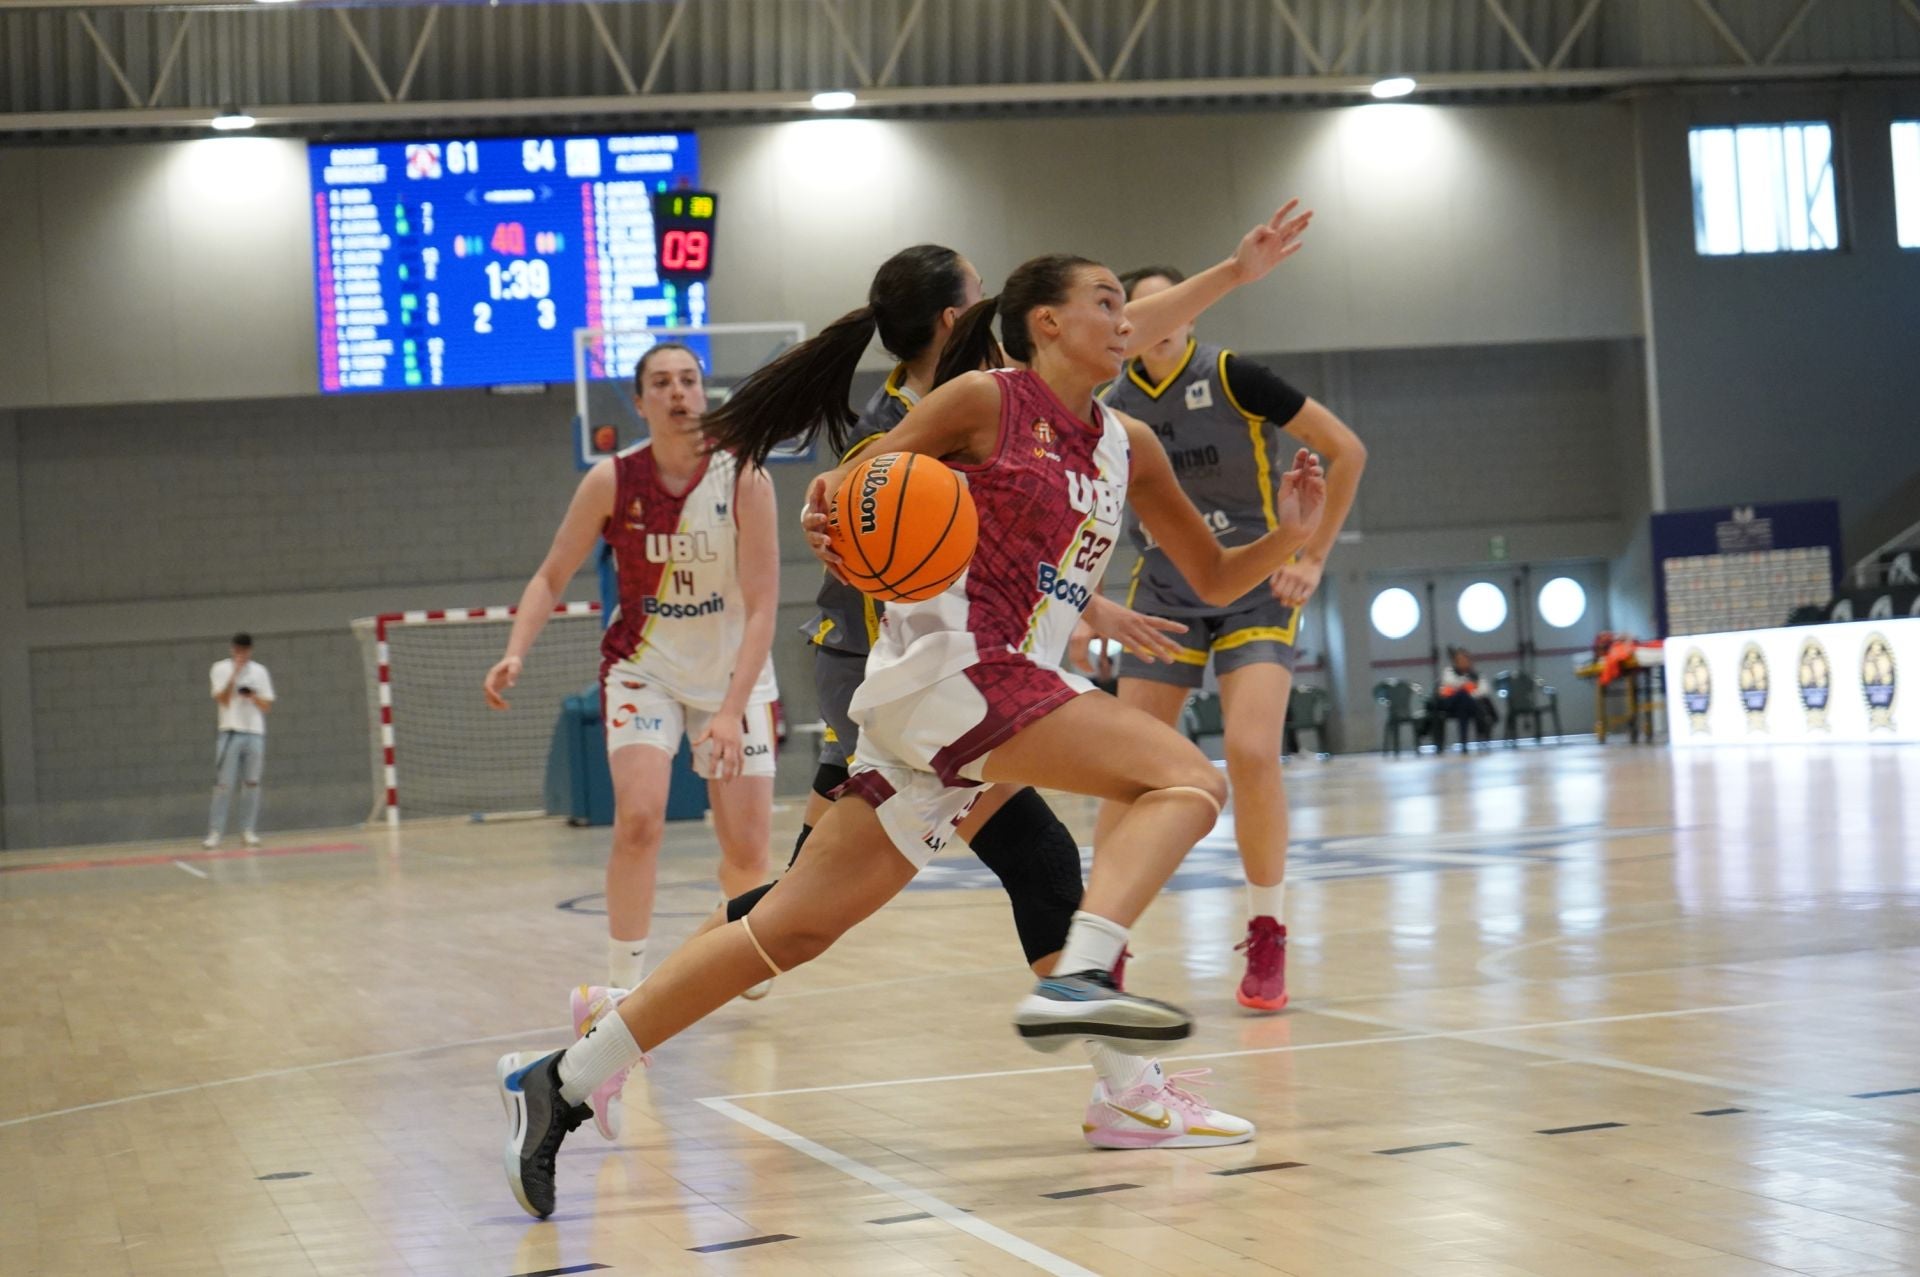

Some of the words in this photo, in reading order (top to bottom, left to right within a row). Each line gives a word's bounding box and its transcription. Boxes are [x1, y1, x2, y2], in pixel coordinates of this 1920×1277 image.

[662, 231, 709, 270] 09
[485, 259, 551, 300] 1:39
[473, 302, 493, 334] 2
[536, 298, 557, 330] 3
[861, 454, 901, 534] Wilson
[645, 531, 717, 563] UBL
[1074, 529, 1111, 573] 22
[672, 570, 694, 596] 14
[635, 715, 662, 730] tvr
